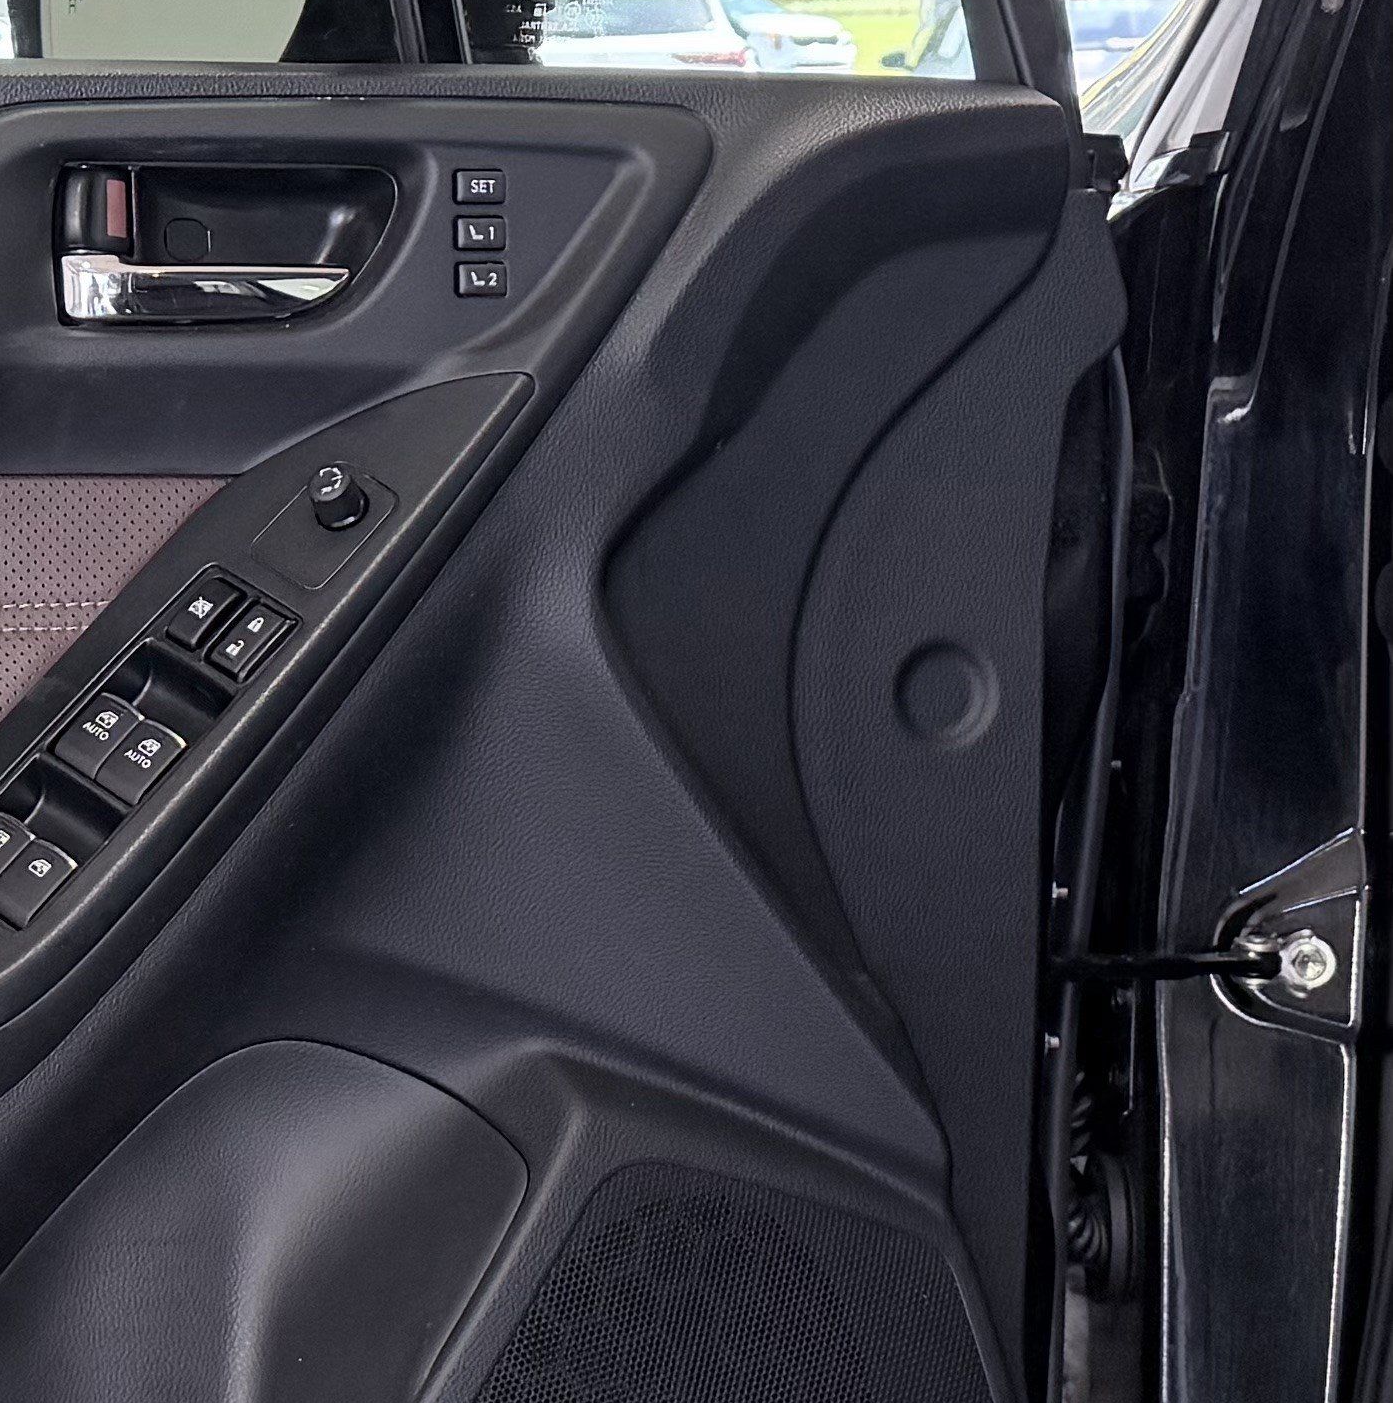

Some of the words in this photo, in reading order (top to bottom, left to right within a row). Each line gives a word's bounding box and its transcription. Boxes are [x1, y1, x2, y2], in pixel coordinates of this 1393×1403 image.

[470, 179, 496, 193] SET
[489, 226, 495, 240] 1
[488, 272, 498, 286] 2
[83, 722, 109, 740] AUTO
[124, 749, 151, 768] AUTO
